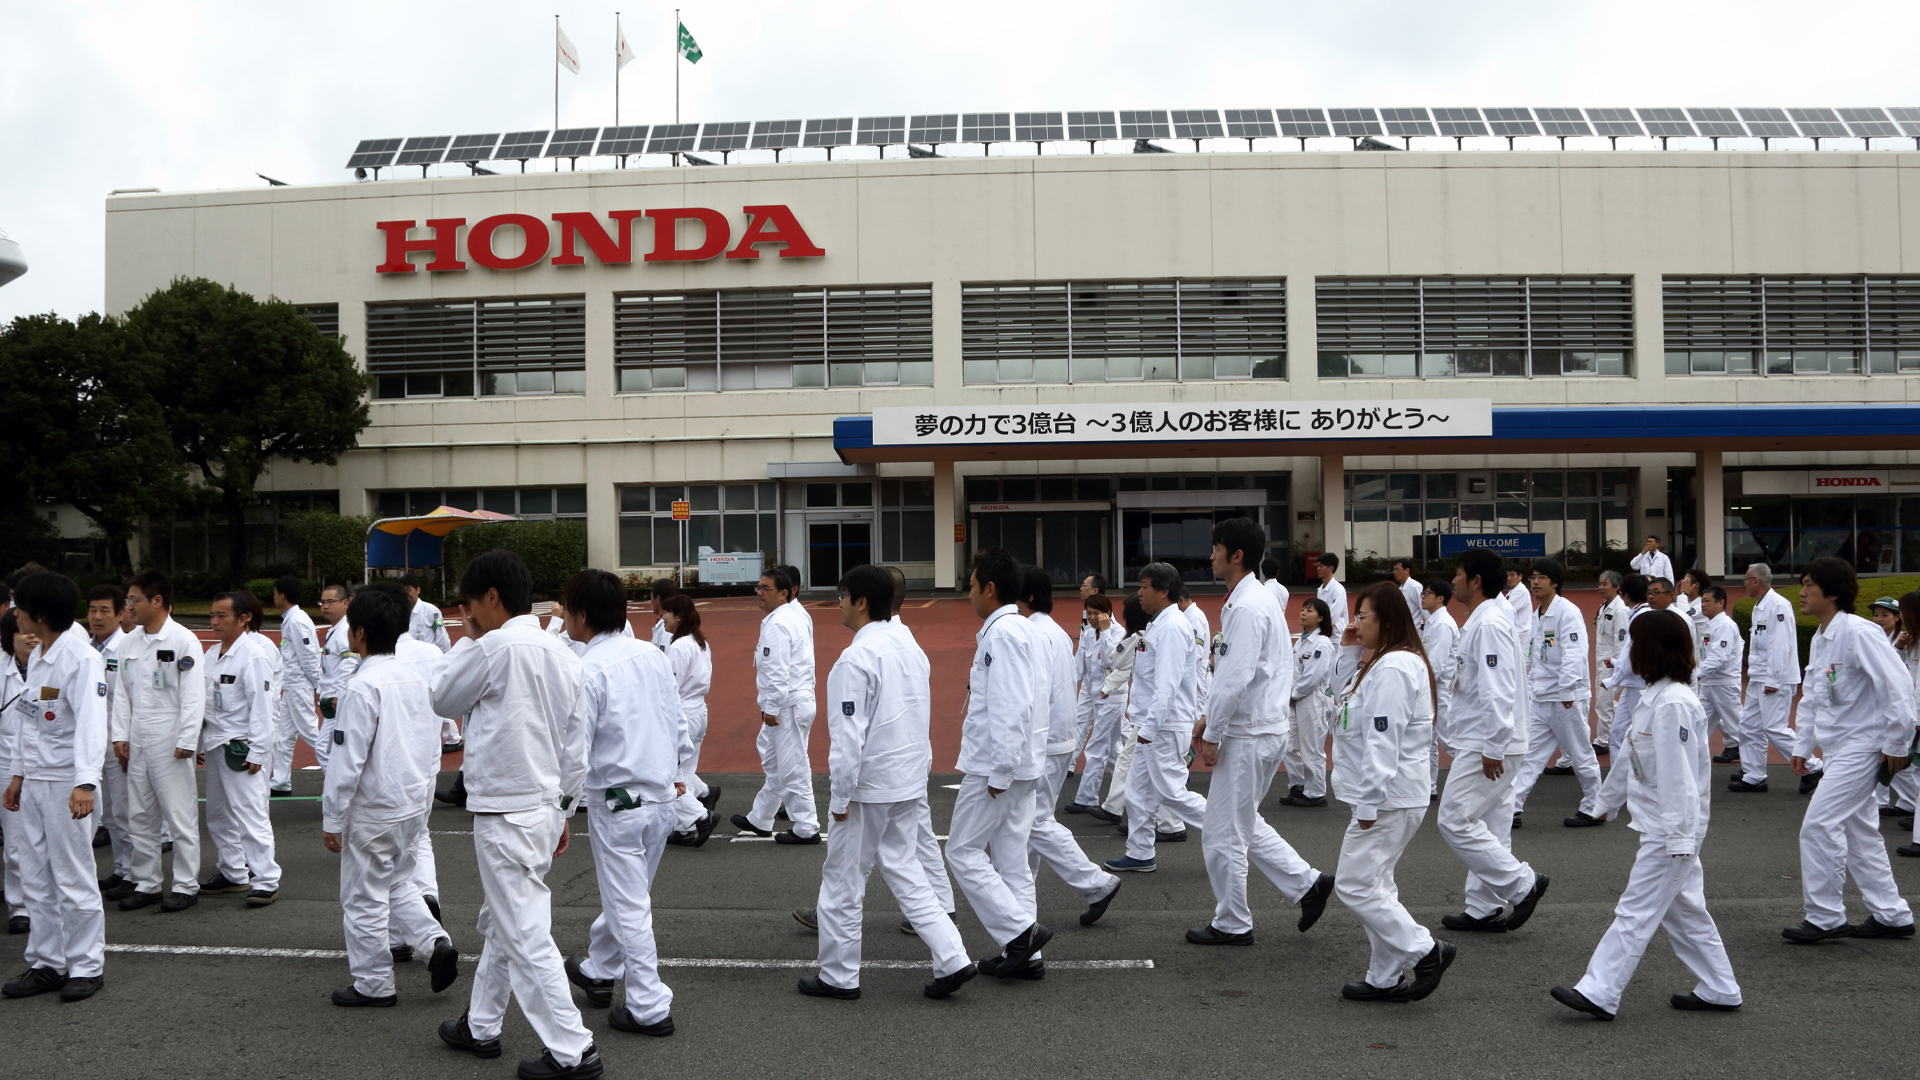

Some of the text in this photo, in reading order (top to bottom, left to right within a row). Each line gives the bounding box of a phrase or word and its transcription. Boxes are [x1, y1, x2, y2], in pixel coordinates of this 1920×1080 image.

[376, 205, 826, 273] HONDA
[915, 412, 1077, 437] 夢の力で3億台
[1816, 477, 1882, 487] HONDA
[1466, 538, 1520, 548] WELCOME
